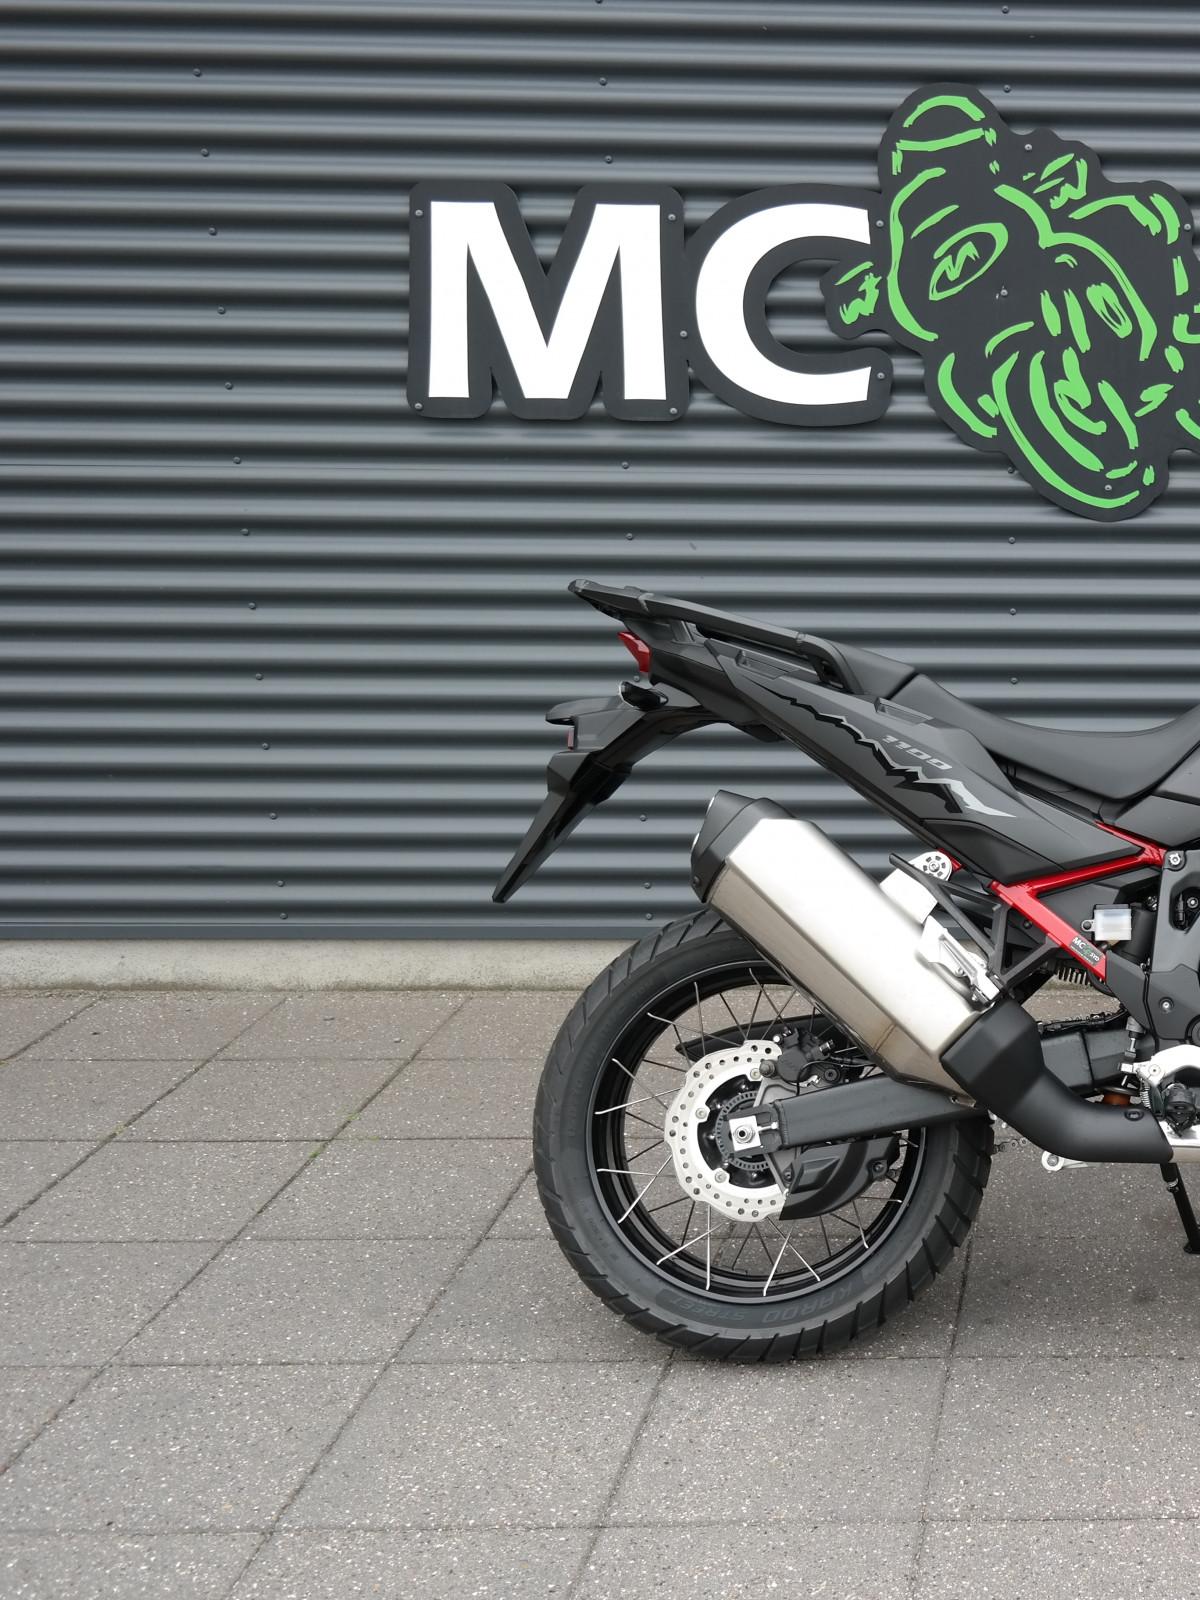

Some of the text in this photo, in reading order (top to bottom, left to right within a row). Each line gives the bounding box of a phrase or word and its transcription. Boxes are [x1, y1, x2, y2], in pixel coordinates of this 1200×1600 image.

[428, 200, 872, 405] MC
[882, 735, 953, 770] 1100
[1072, 937, 1086, 950] MC
